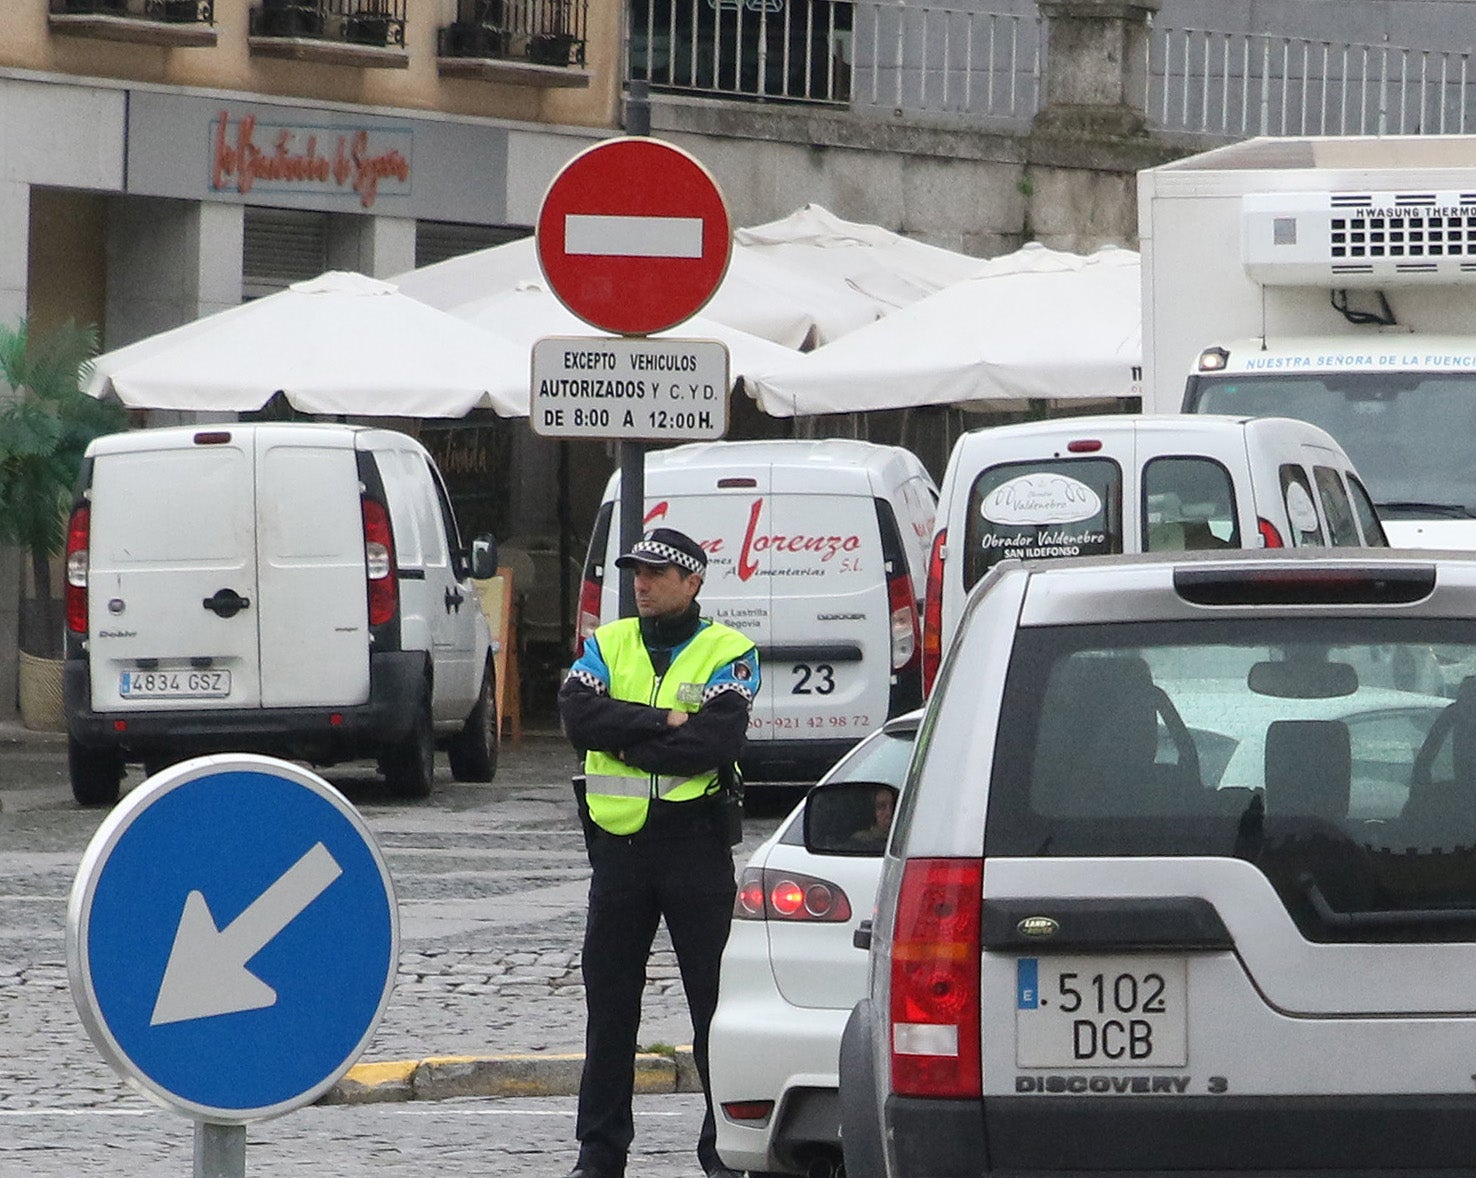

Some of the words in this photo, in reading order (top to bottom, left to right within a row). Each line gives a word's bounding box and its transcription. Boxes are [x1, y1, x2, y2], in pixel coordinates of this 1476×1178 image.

[1356, 207, 1419, 218] HWASUNG
[564, 351, 616, 370] EXCEPTO
[630, 353, 697, 372] VEHICULOS
[1246, 356, 1311, 370] NUESTRA
[1317, 353, 1373, 366] SEÑORA
[1379, 355, 1396, 366] DE
[1402, 355, 1418, 366] LA
[540, 379, 645, 399] AUTORIZADOS
[652, 383, 660, 399] Y
[689, 384, 699, 400] Y
[703, 384, 718, 400] D.
[544, 409, 564, 427] DE
[574, 408, 609, 427] 8:00
[623, 410, 635, 428] A
[649, 411, 695, 429] 12:00
[699, 411, 713, 429] H.
[738, 497, 860, 583] Lorenzo
[982, 533, 1034, 549] Obrador
[1038, 530, 1105, 546] Valdenebro
[1004, 548, 1024, 558] SAN
[1026, 546, 1080, 558] ILDEFONSO
[133, 673, 180, 691] 4834
[188, 673, 223, 691] GSZ
[791, 664, 836, 695] 23
[807, 718, 823, 728] 42
[829, 717, 847, 727] 98
[853, 716, 870, 726] 72
[1059, 973, 1166, 1013] 5102
[1073, 1019, 1153, 1060] DCB
[1015, 1075, 1192, 1094] DISCOVERY
[1207, 1075, 1229, 1094] 3
